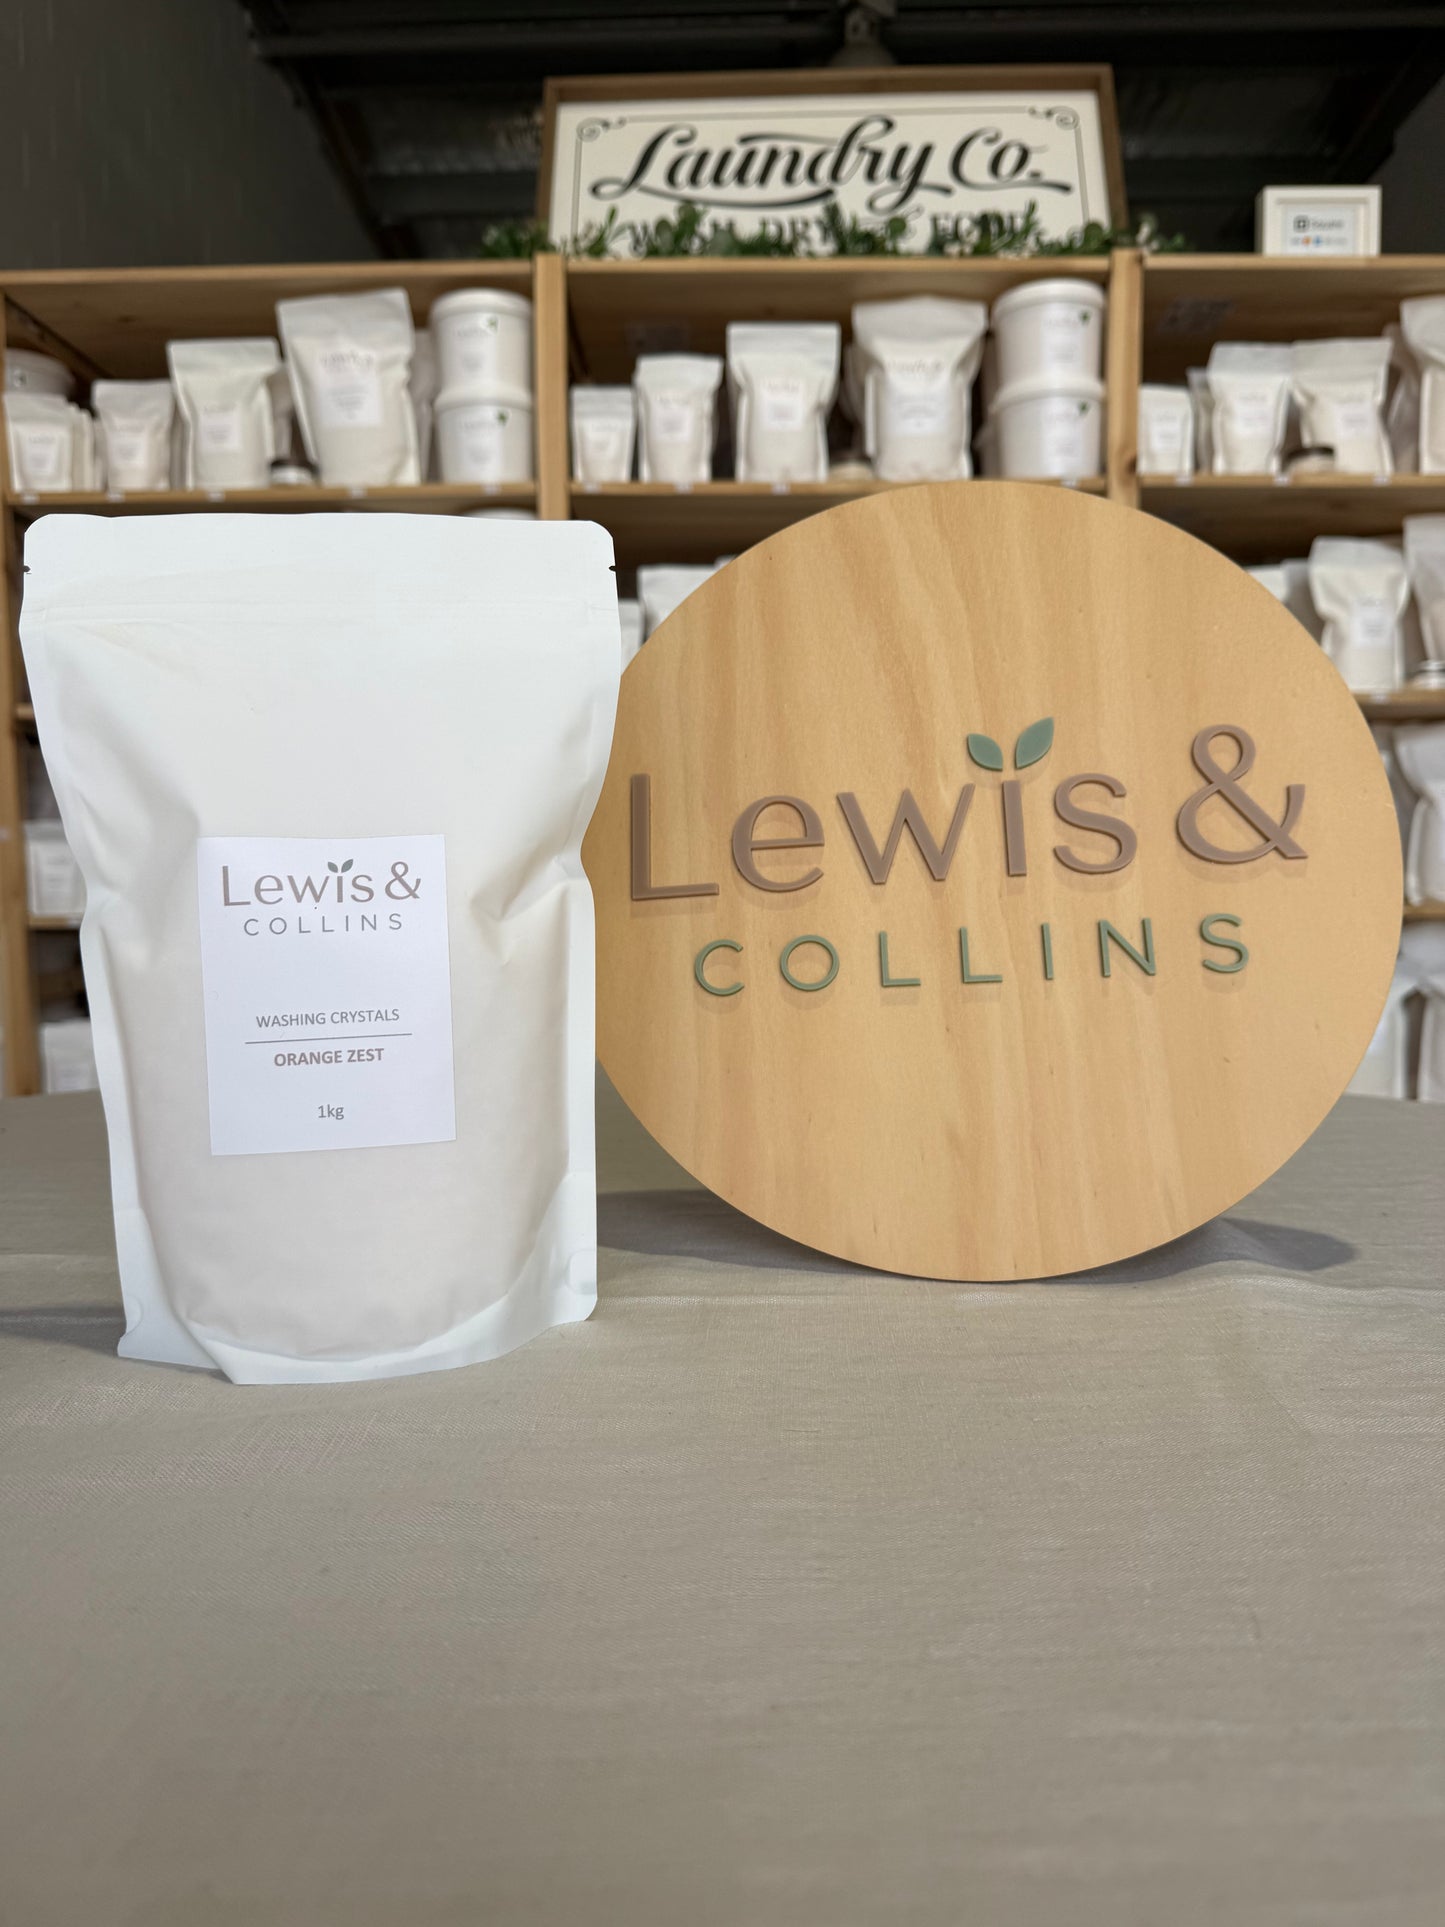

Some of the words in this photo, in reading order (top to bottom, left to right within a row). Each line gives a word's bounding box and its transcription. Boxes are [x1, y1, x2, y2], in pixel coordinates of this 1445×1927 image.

[589, 115, 953, 217] Laundry
[949, 126, 1072, 192] Co.
[631, 717, 1138, 901] Lewis
[1176, 725, 1308, 864] &
[222, 859, 375, 907] Lewis
[384, 861, 422, 900] &
[243, 913, 403, 936] COLLINS
[694, 914, 1249, 996] COLLINS
[256, 1012, 326, 1028] WASHING
[330, 1008, 400, 1025] CRYSTALS
[274, 1050, 343, 1067] ORANGE
[347, 1048, 385, 1062] ZEST
[317, 1104, 345, 1120] 1kg
